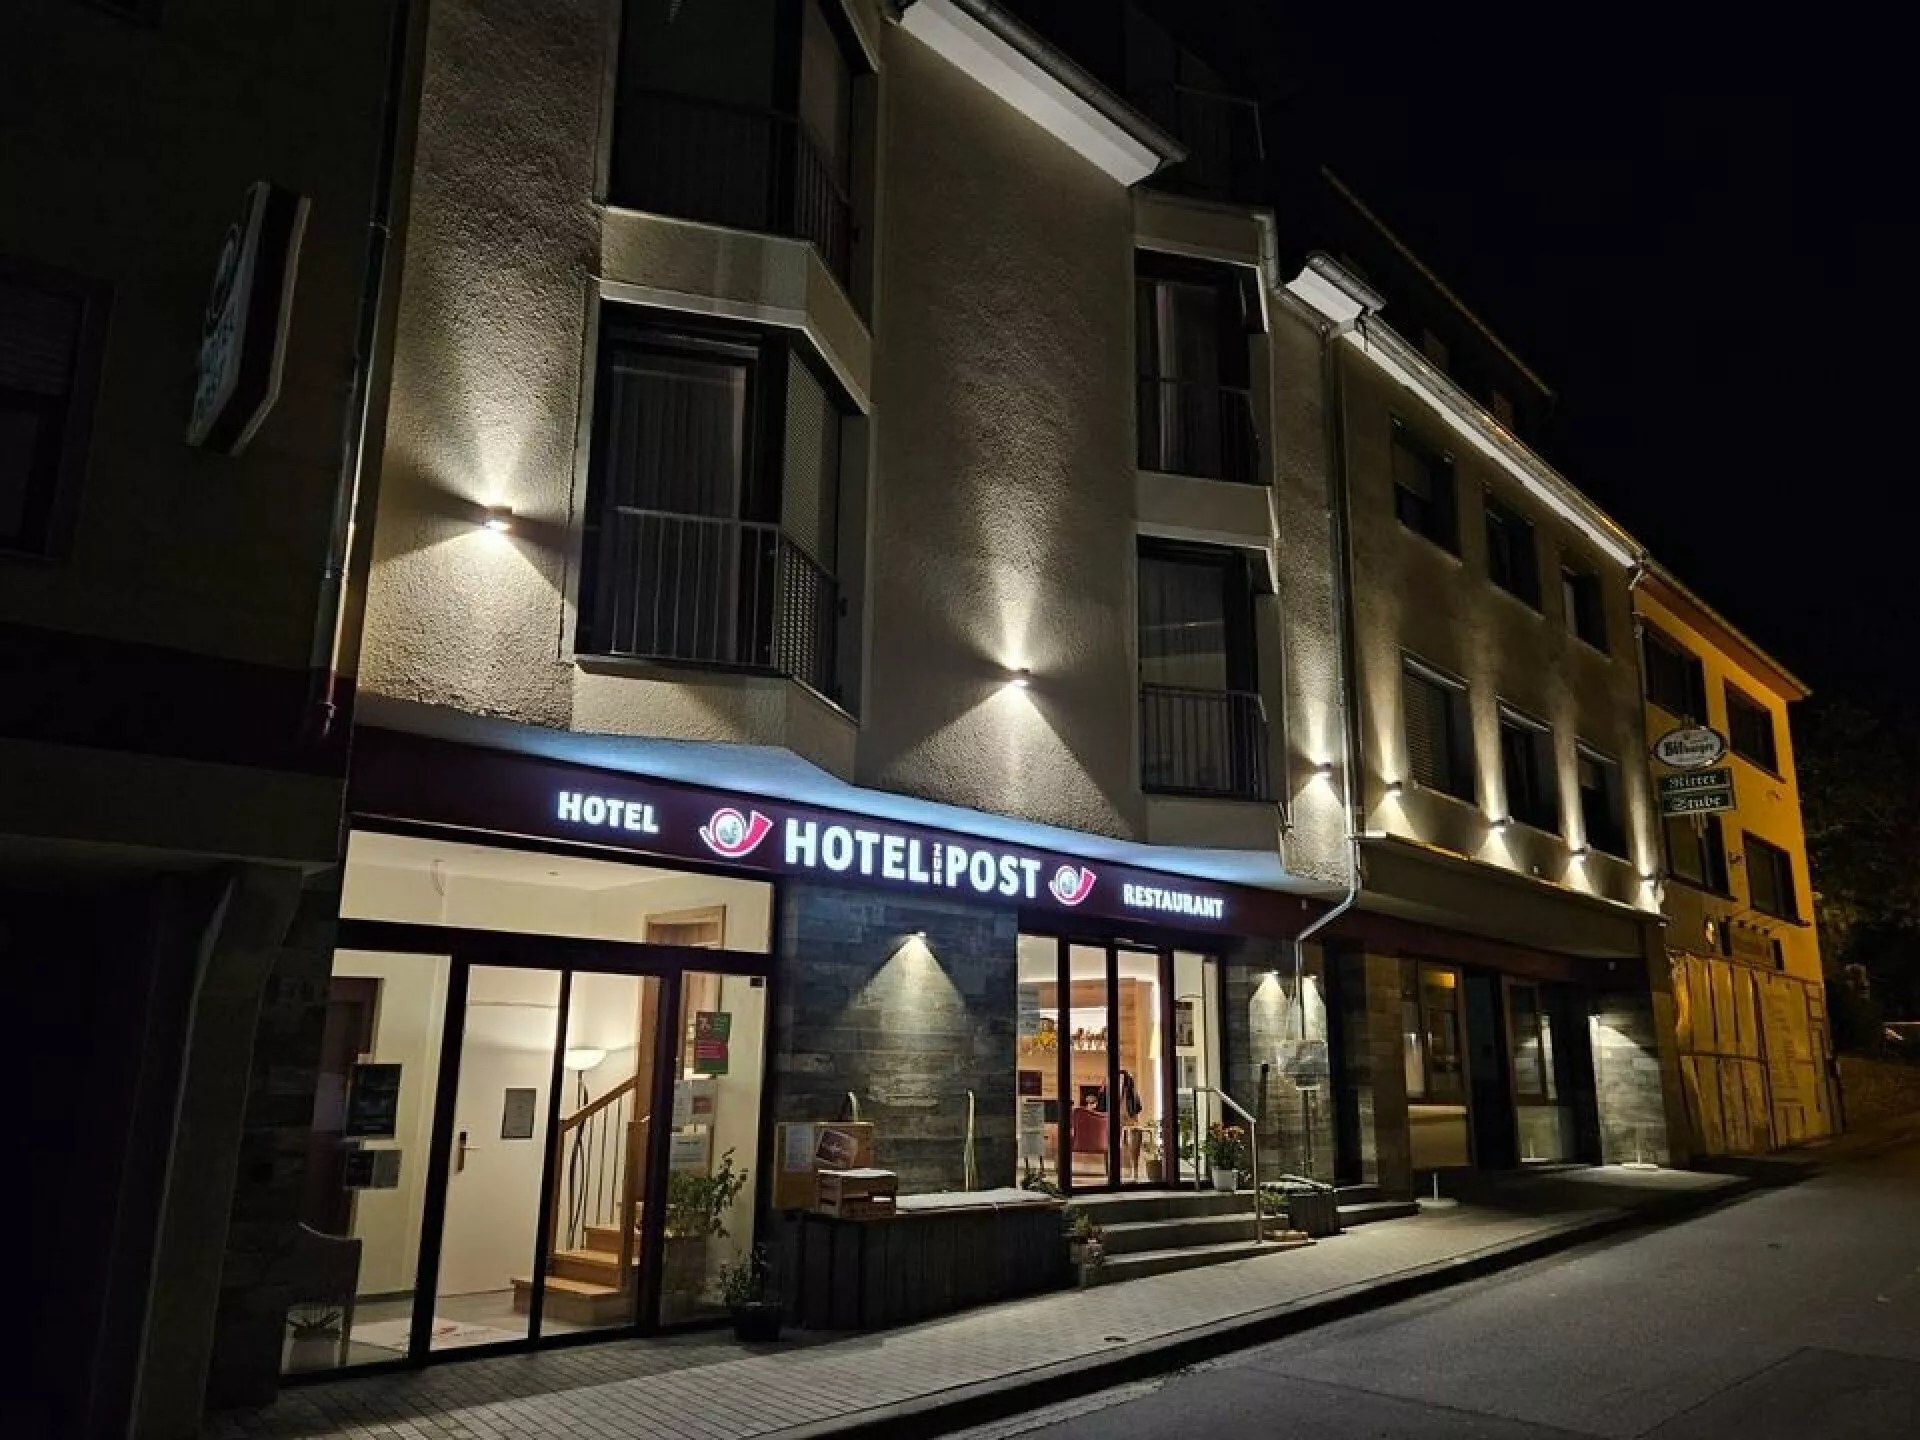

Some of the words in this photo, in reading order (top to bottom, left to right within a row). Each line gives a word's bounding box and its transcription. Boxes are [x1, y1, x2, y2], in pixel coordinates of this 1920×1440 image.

[556, 790, 659, 834] HOTEL
[784, 817, 931, 884] HOTEL
[945, 842, 1041, 899] POST
[1122, 884, 1224, 919] RESTAURANT
